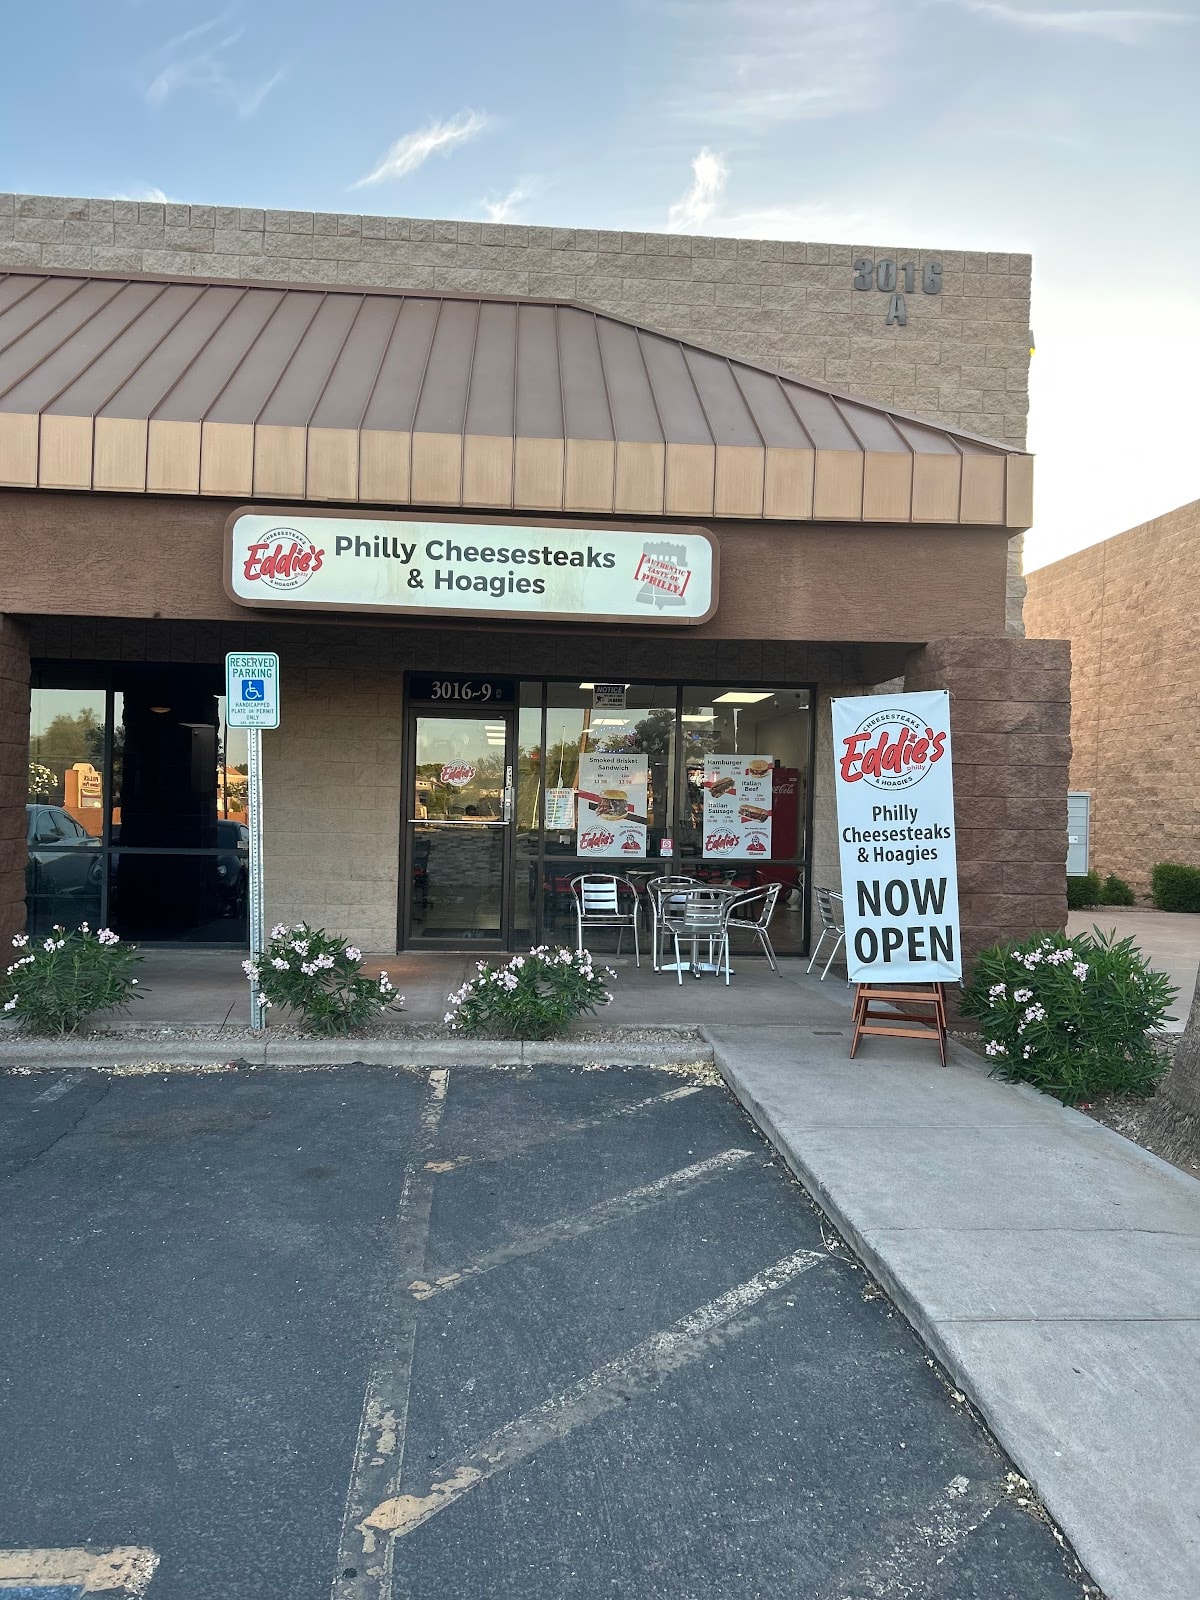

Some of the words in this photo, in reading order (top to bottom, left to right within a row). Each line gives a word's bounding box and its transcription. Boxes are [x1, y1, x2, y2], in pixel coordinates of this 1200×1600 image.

[853, 258, 943, 294] 3016
[885, 293, 907, 326] A
[263, 531, 306, 545] CHEESESTEAKS
[244, 542, 325, 580] Eddie's
[335, 535, 417, 564] Philly
[425, 539, 616, 569] Cheesesteaks
[645, 557, 686, 577] AUTHENTIC
[648, 566, 668, 579] TASTE
[669, 574, 680, 582] OF
[407, 568, 424, 589] &
[434, 569, 545, 597] Hoagies
[641, 572, 681, 593] PHILLY
[230, 657, 275, 668] RESERVED
[232, 668, 272, 678] PARKING
[863, 714, 920, 732] CHEESESTEAKS
[840, 727, 947, 782] Eddie's
[441, 766, 476, 782] Eddie's
[881, 776, 913, 787] HOAGIES
[872, 804, 918, 824] Philly
[579, 831, 615, 849] Eddie's
[705, 833, 740, 851] Eddie's
[842, 823, 951, 843] Cheesesteaks
[857, 847, 869, 863] &
[874, 845, 938, 865] Hoagies
[856, 877, 948, 917] NOW
[854, 924, 954, 964] OPEN
